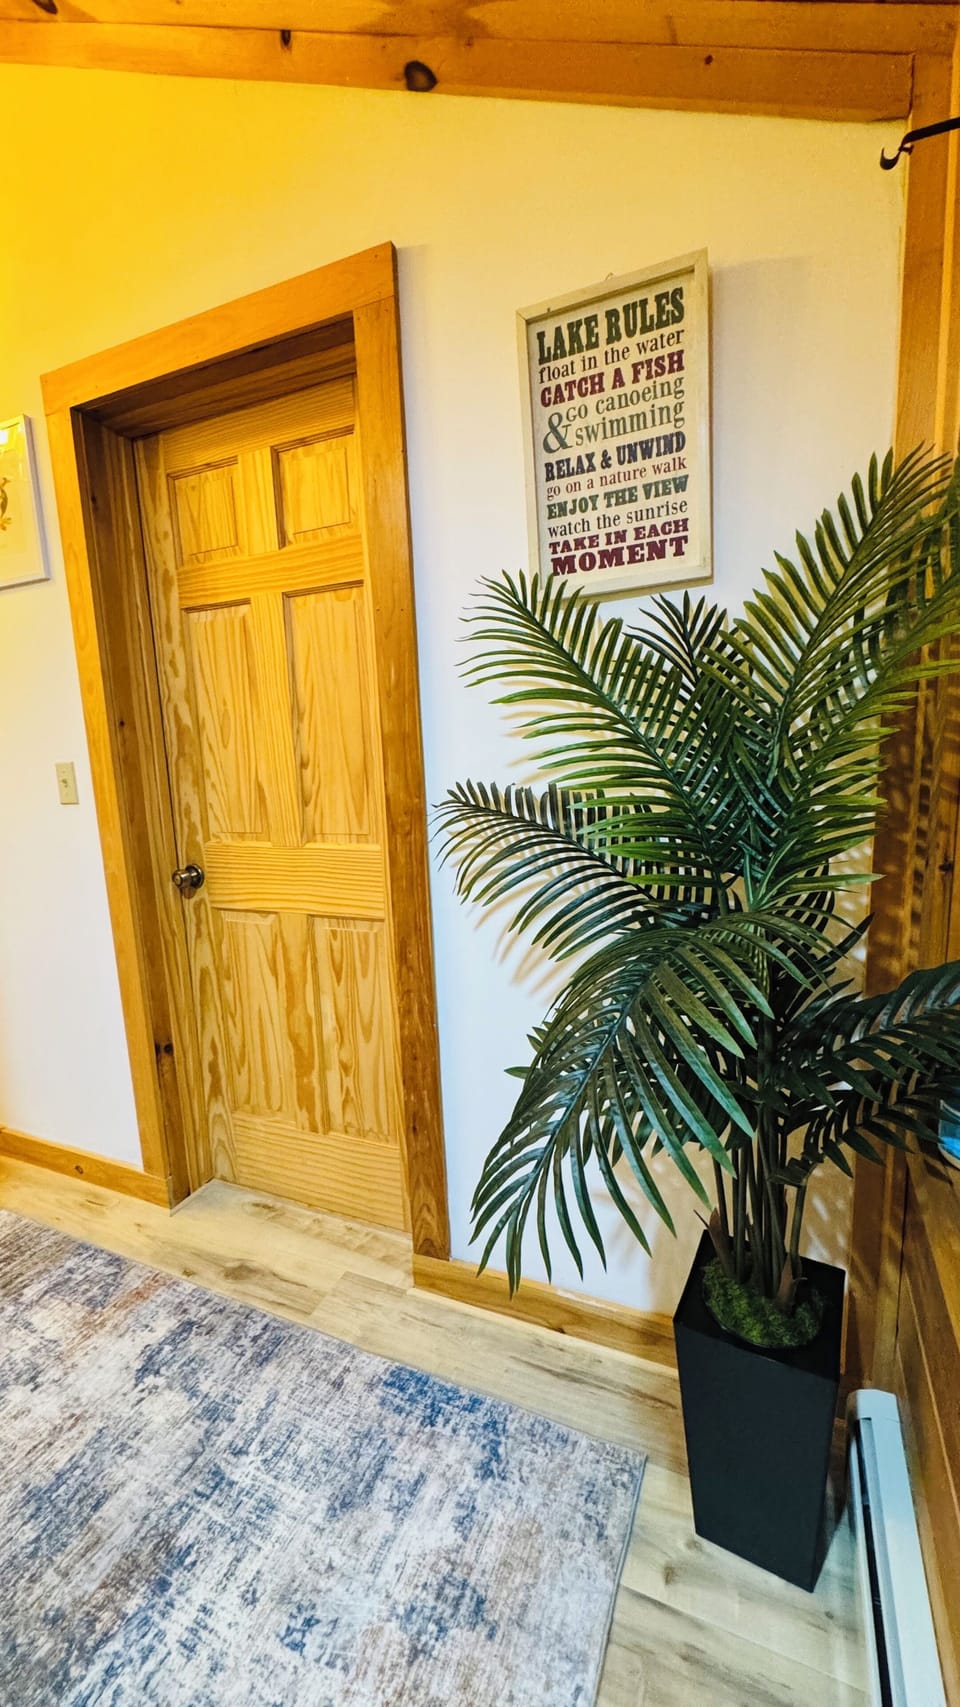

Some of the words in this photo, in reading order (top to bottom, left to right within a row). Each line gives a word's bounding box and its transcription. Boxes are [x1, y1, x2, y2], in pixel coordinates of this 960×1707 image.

[537, 314, 599, 365] LAKE
[605, 287, 684, 345] RULES
[539, 362, 576, 384] float
[582, 355, 597, 371] in
[605, 345, 629, 365] the
[636, 329, 684, 355] water
[541, 372, 605, 407] CATCH
[612, 368, 625, 389] A
[632, 350, 684, 384] FISH
[543, 412, 572, 453] &
[596, 377, 684, 414] canoeing
[576, 402, 684, 446] swimming
[545, 452, 596, 482] RELAX
[601, 450, 612, 469] &
[616, 431, 686, 465] UNWIND
[547, 486, 560, 500] go
[566, 481, 581, 493] on
[587, 479, 594, 489] a
[600, 466, 646, 487] nature
[652, 456, 687, 475] walk
[547, 495, 599, 519] ENJOY
[604, 486, 638, 508] THE
[643, 475, 689, 500] VIEW
[548, 518, 590, 538] watch
[596, 514, 620, 529] the
[627, 500, 687, 524] sunrise
[549, 534, 599, 554] TAKE
[606, 529, 627, 545] IN
[634, 518, 689, 540] EACH
[551, 535, 688, 576] MOMENT
